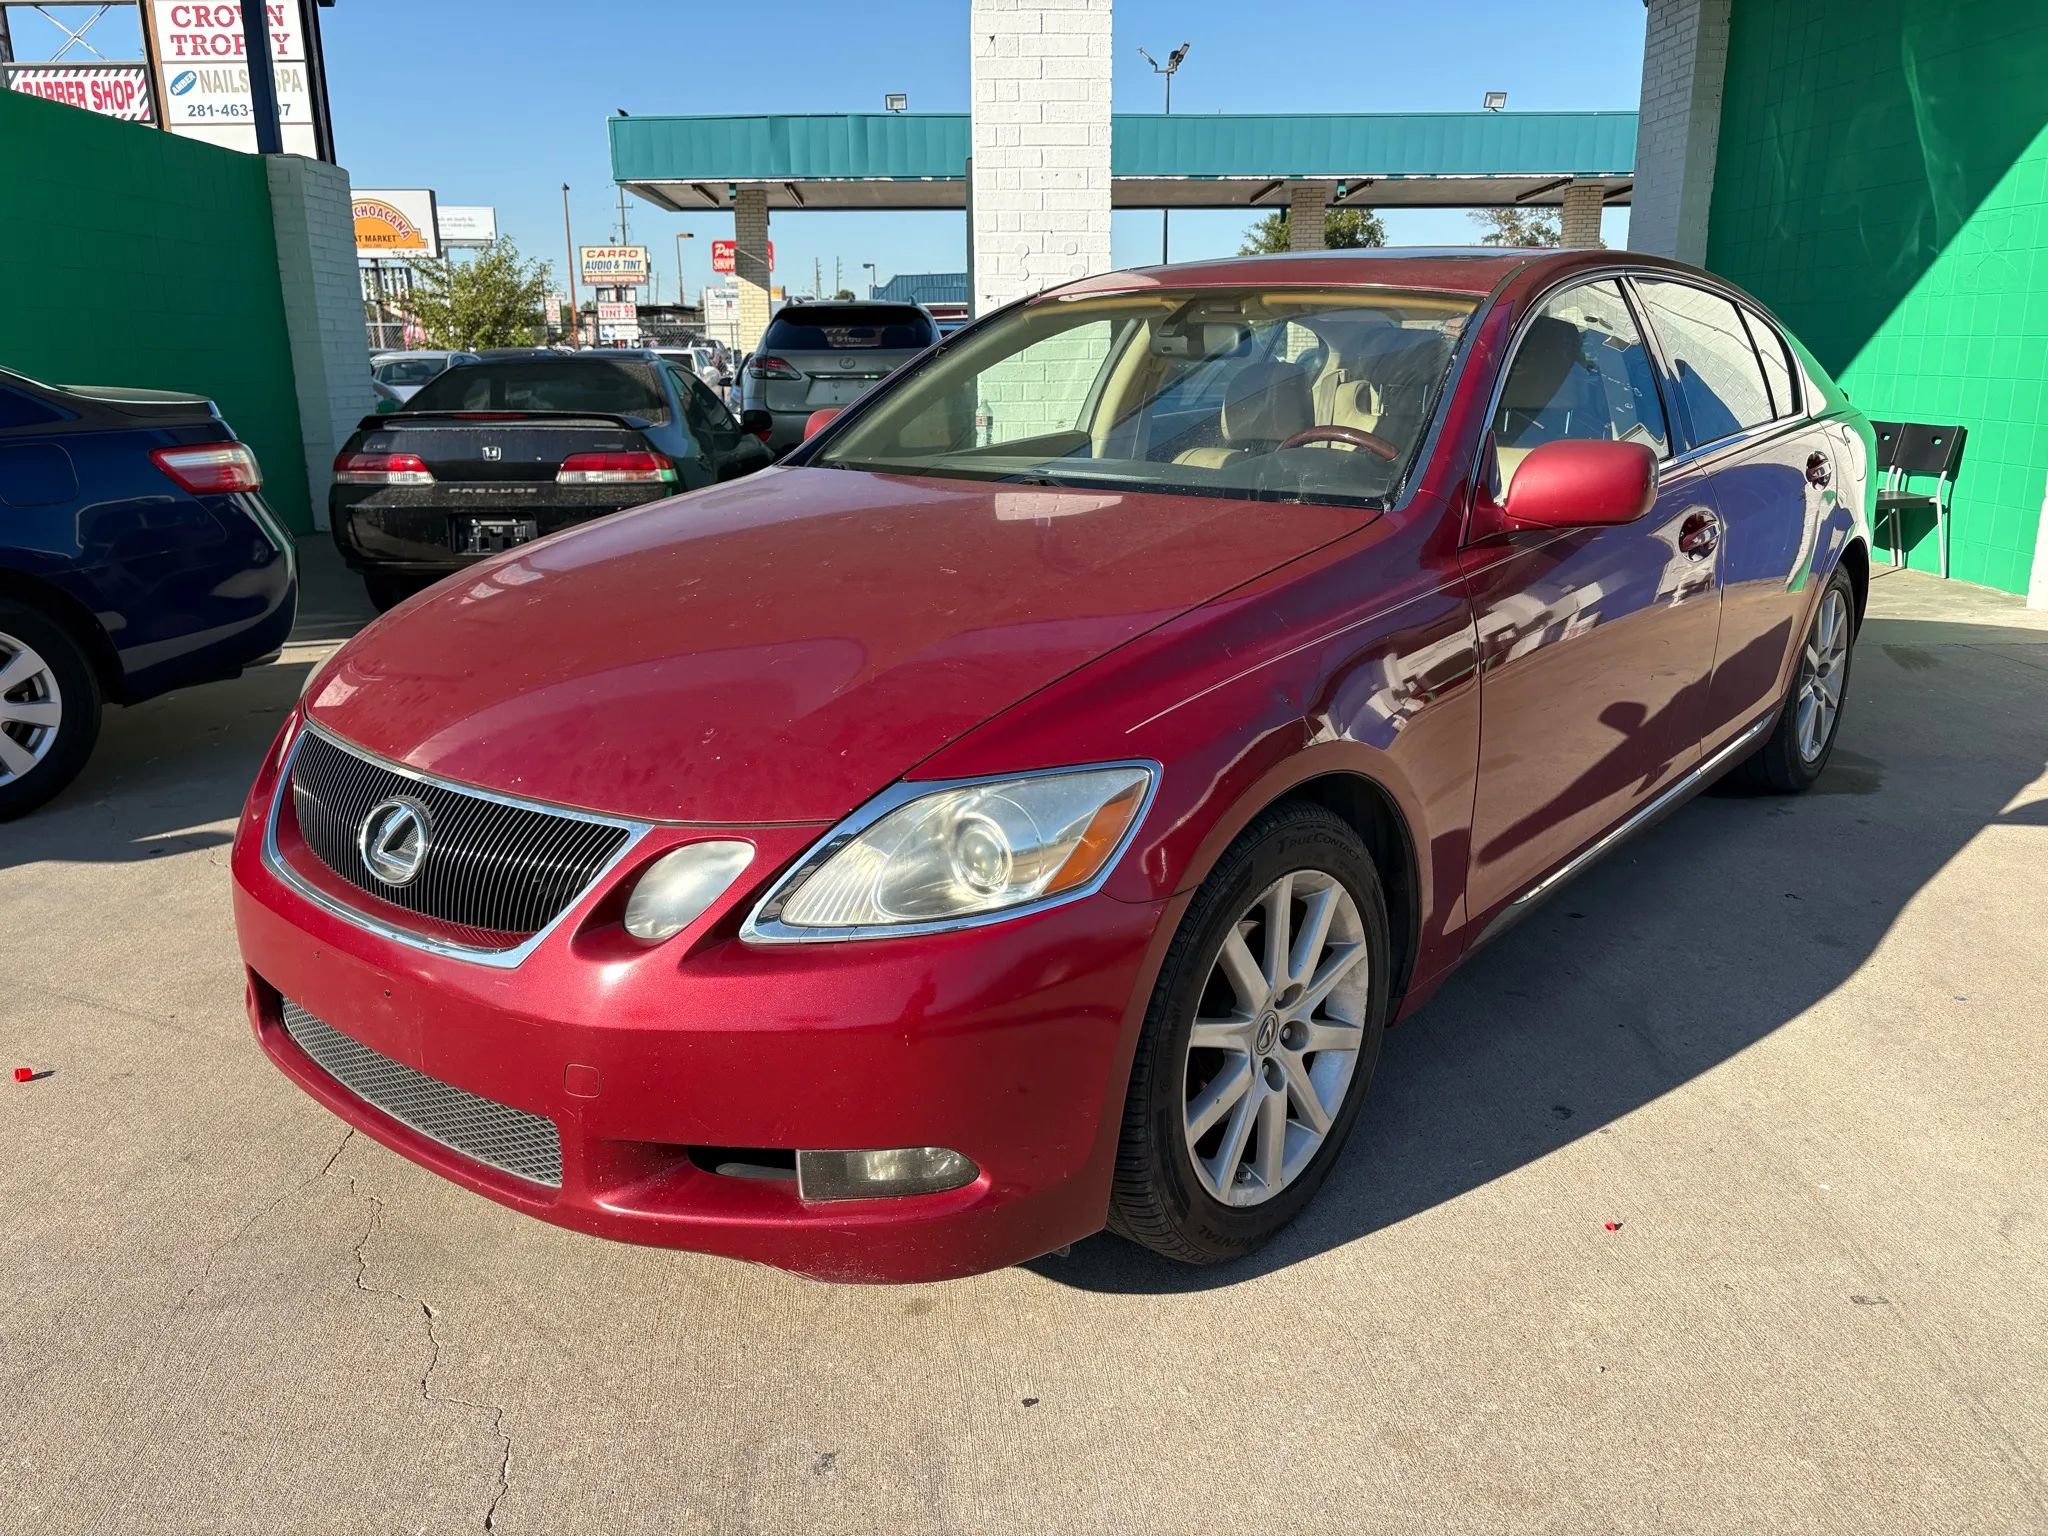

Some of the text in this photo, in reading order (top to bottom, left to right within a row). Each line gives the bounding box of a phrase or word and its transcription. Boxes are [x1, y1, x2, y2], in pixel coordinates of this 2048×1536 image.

[170, 4, 284, 28] CRON
[169, 33, 290, 56] TROPY
[171, 71, 196, 95] AMBER
[198, 69, 250, 94] NAILS
[90, 79, 135, 110] SHOP
[187, 103, 291, 117] 281-463-7
[353, 205, 410, 238] CHOACANA
[364, 234, 396, 242] MARKET
[584, 260, 642, 270] AUDIO & TINT
[586, 249, 639, 258] CARRO
[600, 309, 621, 318] TINT
